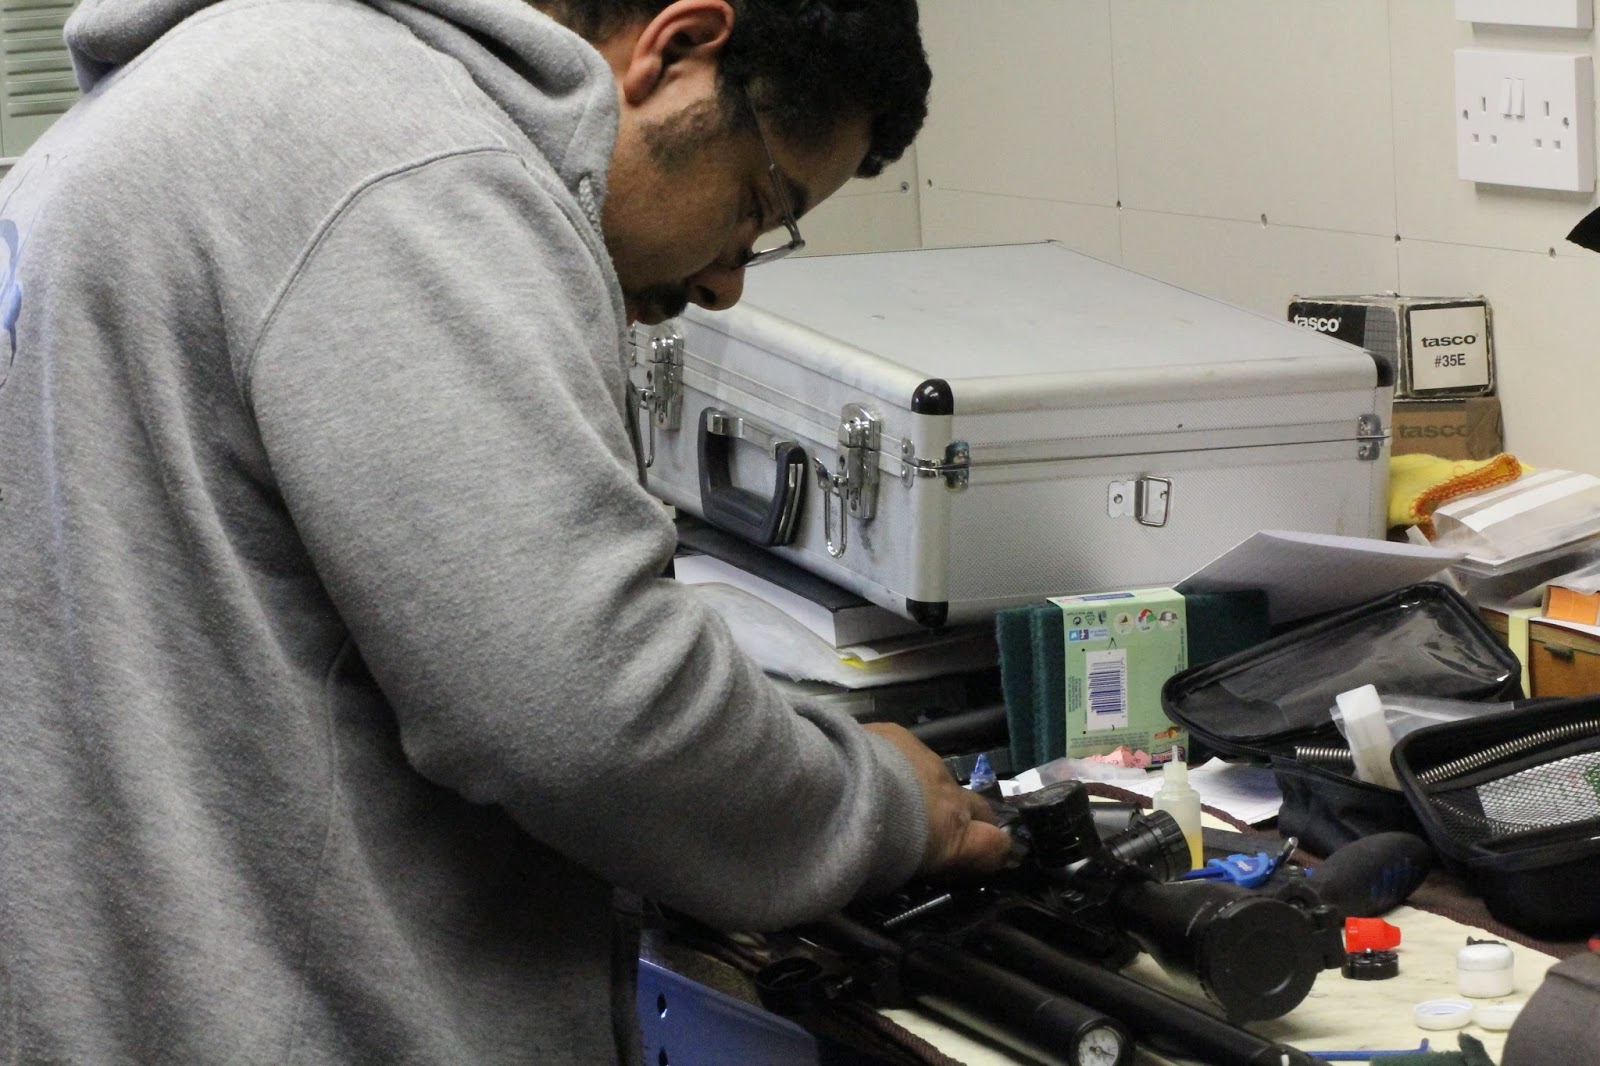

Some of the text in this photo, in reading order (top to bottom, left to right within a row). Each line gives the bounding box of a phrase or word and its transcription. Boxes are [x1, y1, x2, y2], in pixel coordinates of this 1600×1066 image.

[1293, 314, 1340, 332] tasco
[1421, 334, 1476, 348] tasco
[1434, 353, 1466, 368] #35E
